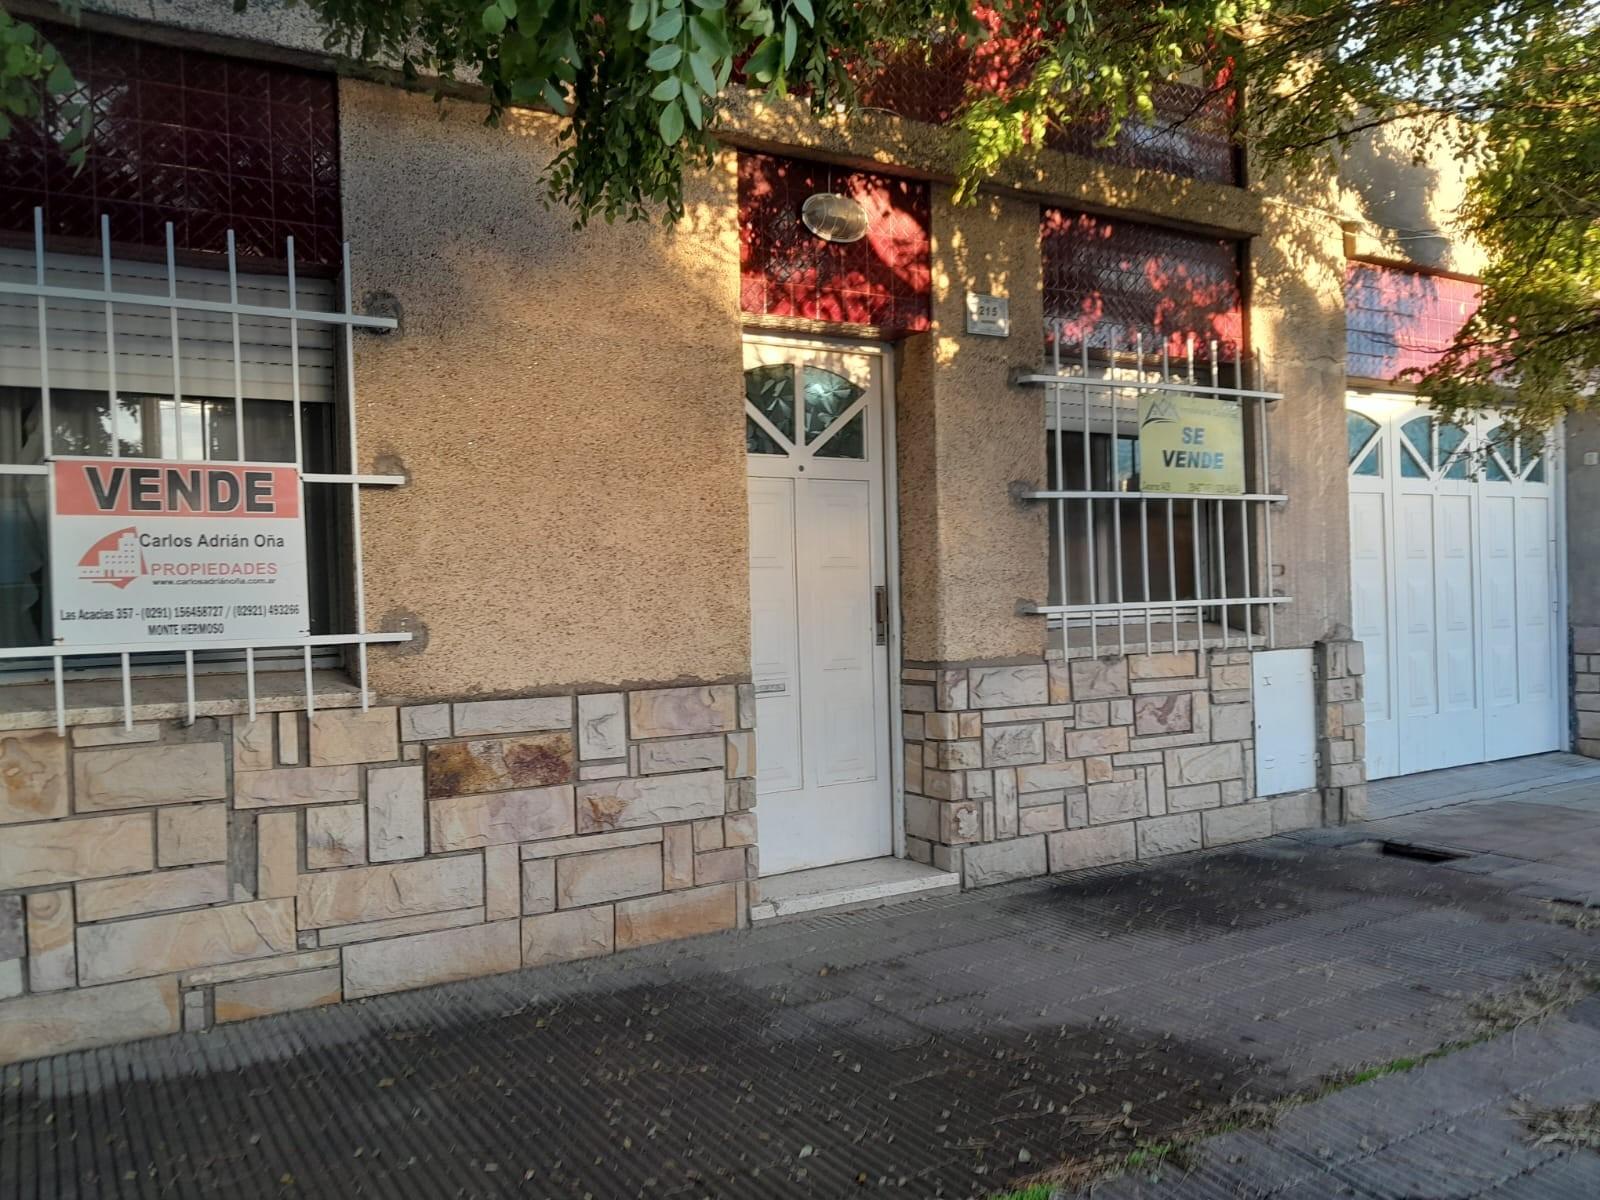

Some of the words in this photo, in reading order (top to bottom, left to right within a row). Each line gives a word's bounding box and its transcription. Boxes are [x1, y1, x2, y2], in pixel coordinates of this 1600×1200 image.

[1182, 427, 1205, 445] SE
[1162, 449, 1225, 470] VENDE
[83, 465, 276, 513] VENDE
[139, 533, 193, 548] Carlos
[197, 533, 249, 548] Adrián
[254, 534, 285, 548] Oña
[151, 563, 278, 576] PROPIEDADES
[60, 609, 76, 620] Las
[78, 609, 114, 620] Acacias
[116, 608, 134, 619] 357
[141, 607, 172, 620] (0291)
[233, 605, 266, 618] (02921)
[148, 624, 179, 636] MONTE
[181, 623, 224, 635] HERMOSO
